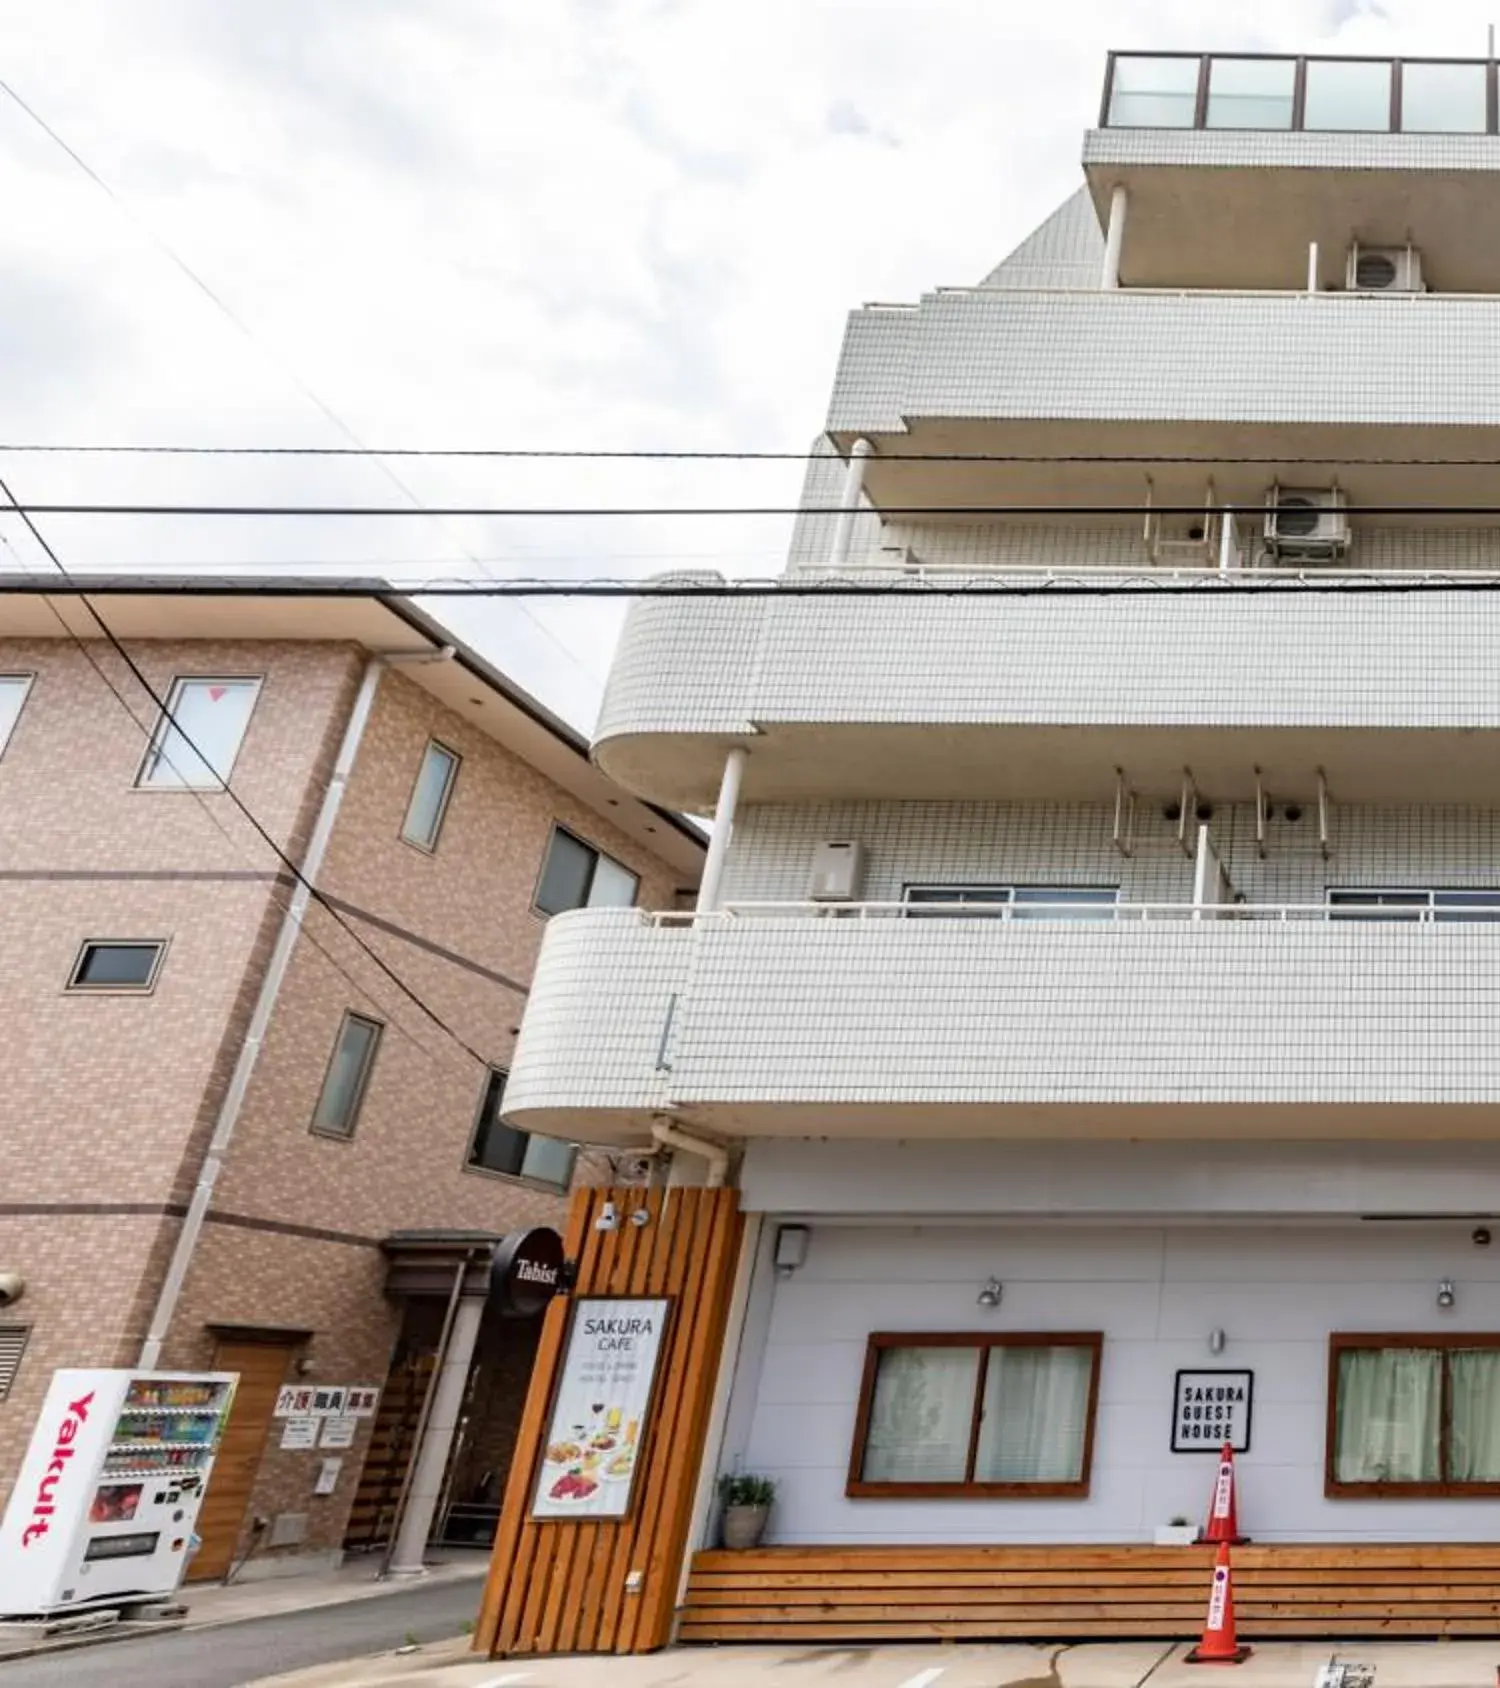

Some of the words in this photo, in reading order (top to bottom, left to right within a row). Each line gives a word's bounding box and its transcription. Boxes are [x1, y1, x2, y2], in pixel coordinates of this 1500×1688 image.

[516, 1259, 558, 1284] Tabist
[583, 1319, 653, 1334] SAKURA
[597, 1337, 633, 1351] CAFE
[1184, 1387, 1244, 1402] SAKURA
[1183, 1405, 1233, 1420] GUEST
[22, 1389, 95, 1547] Yakult
